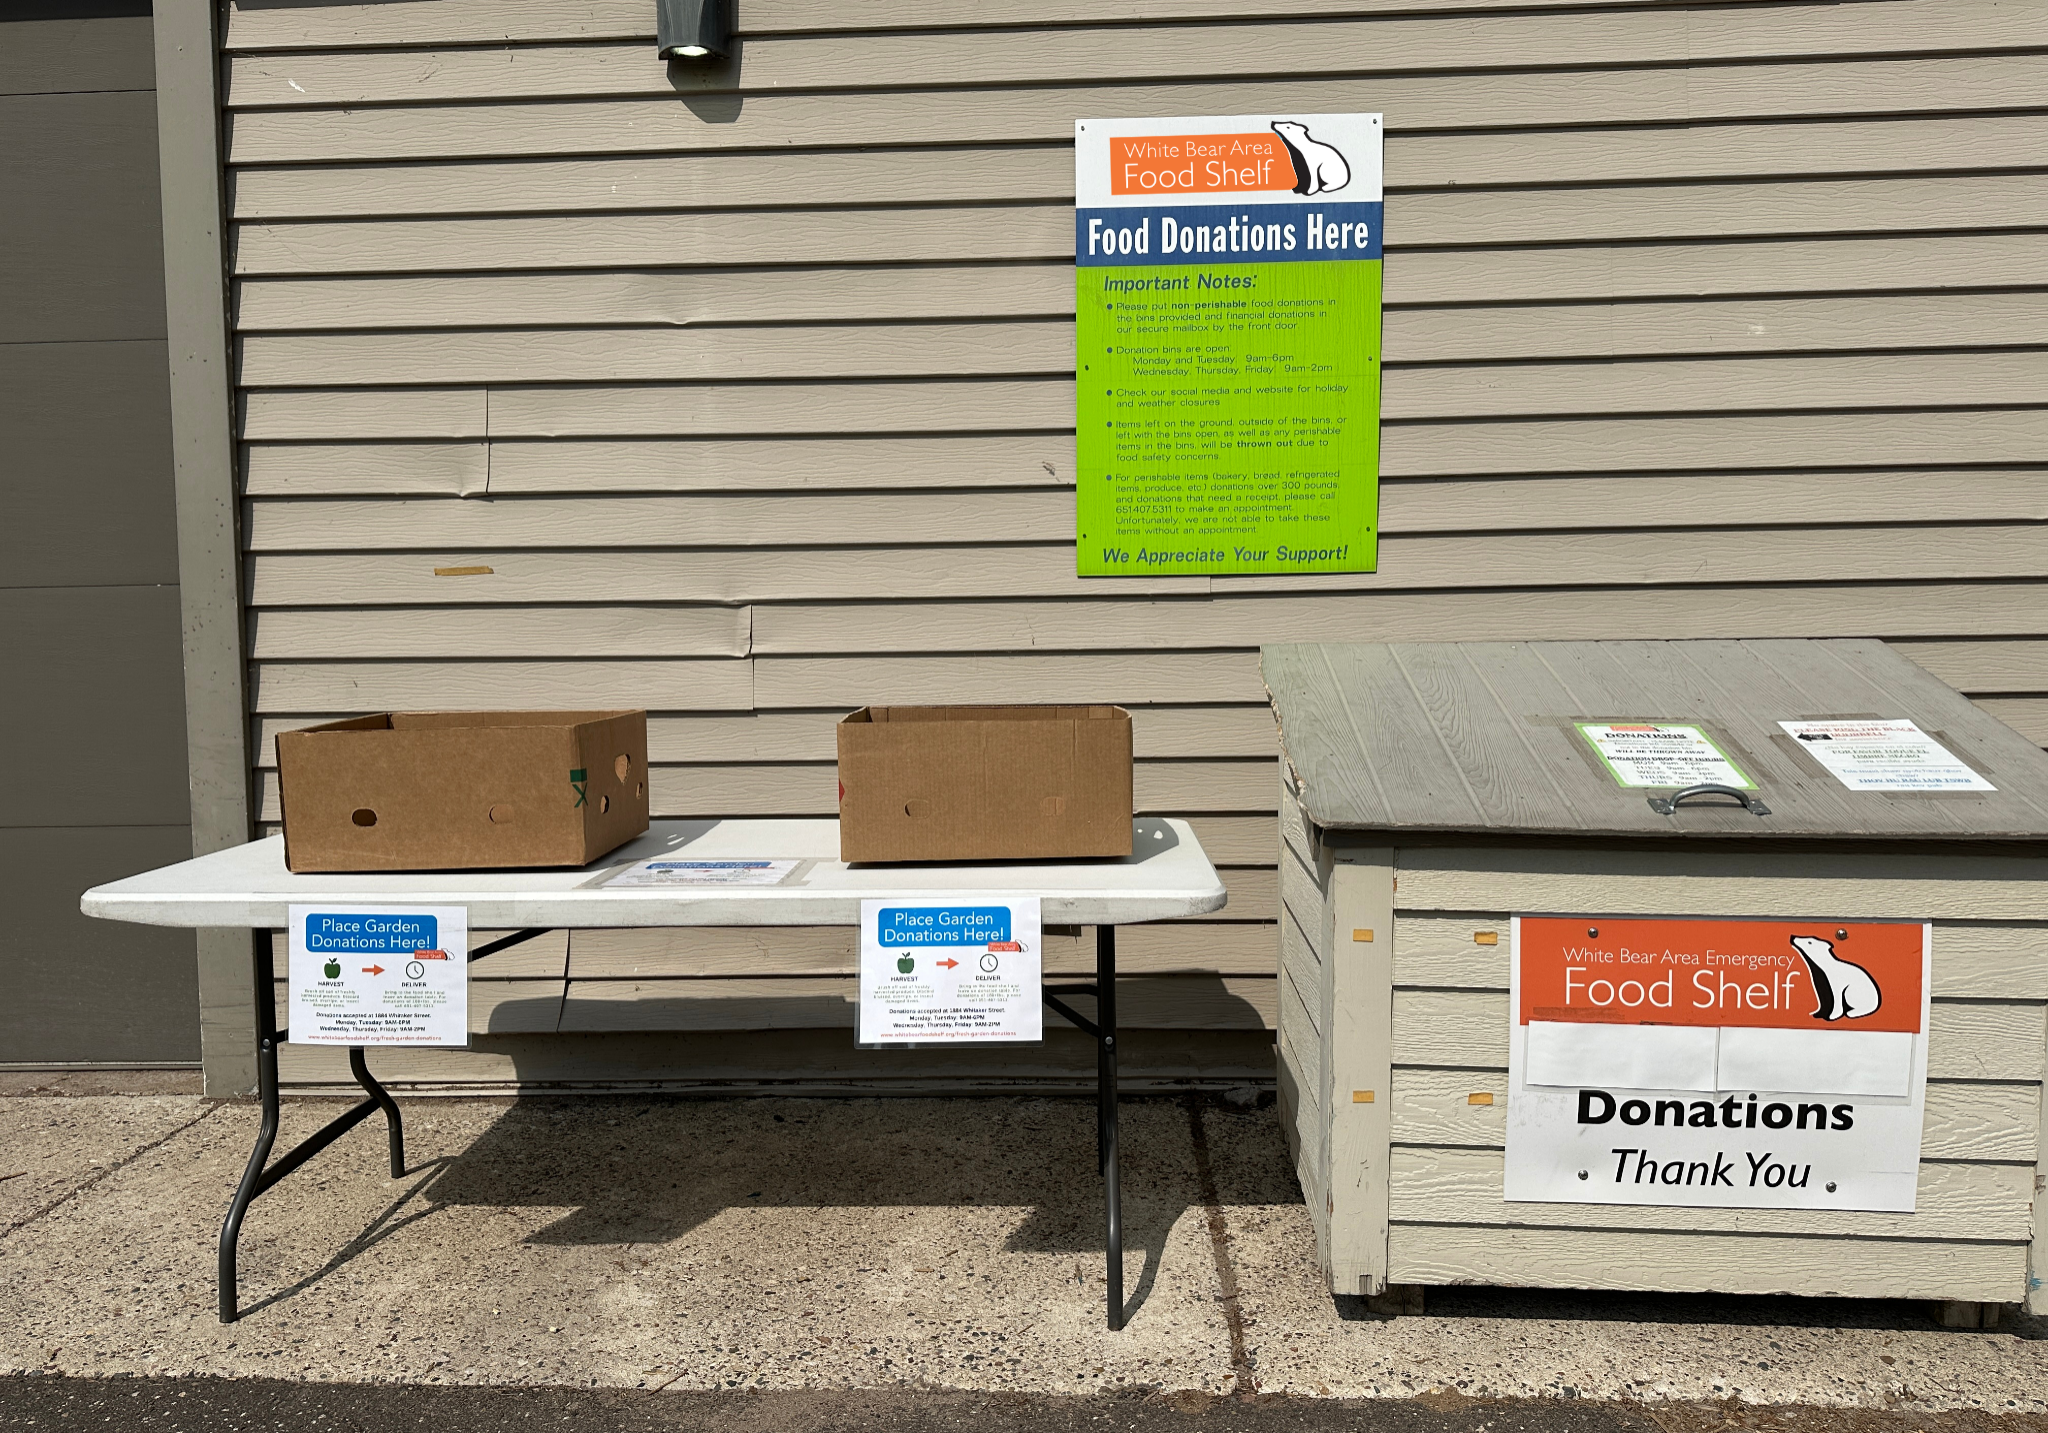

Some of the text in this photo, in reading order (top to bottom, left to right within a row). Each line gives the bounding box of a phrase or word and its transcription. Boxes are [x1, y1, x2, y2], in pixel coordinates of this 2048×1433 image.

[1123, 139, 1273, 158] White Bear Area
[1124, 158, 1275, 189] Food Shelf
[1088, 213, 1369, 256] Food Donations Here
[1104, 273, 1257, 294] Important Notes:
[1116, 302, 1148, 310] Please
[1152, 303, 1167, 311] put
[1171, 300, 1247, 310] non-perishable
[1251, 299, 1273, 307] food
[1277, 299, 1324, 307] donations
[1117, 314, 1132, 322] the
[1136, 313, 1155, 322] bins
[1160, 313, 1200, 322] provided
[1205, 312, 1222, 320] and
[1226, 311, 1265, 320] financial
[1268, 310, 1315, 319] donations
[1173, 324, 1208, 332] mailbox
[1213, 324, 1224, 333] by
[1248, 322, 1271, 330] front
[1116, 346, 1158, 354] Donation
[1163, 346, 1181, 354] bins
[1133, 356, 1171, 366] Monday
[1176, 356, 1192, 364] and
[1246, 354, 1294, 362] 9am-6pm
[1285, 364, 1333, 373] 9am-2pm
[1116, 388, 1146, 396] Check
[1171, 387, 1198, 395] social
[1202, 387, 1229, 395] media
[1234, 386, 1251, 394] and
[1256, 385, 1293, 393] website
[1316, 384, 1349, 393] holiday
[1138, 399, 1176, 407] weather
[1180, 419, 1195, 427] the
[1239, 418, 1273, 426] outside
[1278, 417, 1288, 425] of
[1292, 416, 1307, 424] the
[1116, 431, 1130, 439] left
[1156, 430, 1170, 438] the
[1173, 430, 1191, 438] bins
[1239, 428, 1255, 436] well
[1294, 427, 1341, 437] perishable
[1116, 442, 1141, 450] items
[1157, 441, 1171, 449] the
[1200, 440, 1216, 448] will
[1221, 440, 1232, 448] be
[1237, 440, 1271, 448] thrown
[1297, 439, 1314, 447] due
[1117, 453, 1138, 461] food
[1142, 453, 1171, 462] safety
[1134, 473, 1180, 483] perishable
[1185, 473, 1208, 481] items
[1286, 470, 1340, 479] refrigerated
[1210, 483, 1254, 491] donations
[1282, 481, 1300, 490] 300
[1116, 495, 1133, 503] and
[1137, 494, 1182, 503] donations
[1187, 494, 1203, 502] that
[1208, 493, 1231, 501] need
[1285, 493, 1316, 502] please
[1320, 492, 1335, 500] call
[1189, 505, 1214, 513] make
[1241, 515, 1260, 523] able
[1279, 514, 1299, 522] take
[1116, 527, 1140, 535] items
[1103, 544, 1348, 566] We Appreciate Your Support!
[894, 911, 993, 926] Place Garden
[322, 918, 420, 933] Place Garden
[884, 927, 1004, 942] Donations Here!
[311, 934, 431, 948] Donations Here!
[1563, 946, 1795, 971] White Bear Area Emergency
[1564, 967, 1800, 1010] Food Shelf
[1577, 1089, 1855, 1131] Donations
[1611, 1148, 1812, 1189] Thank You
